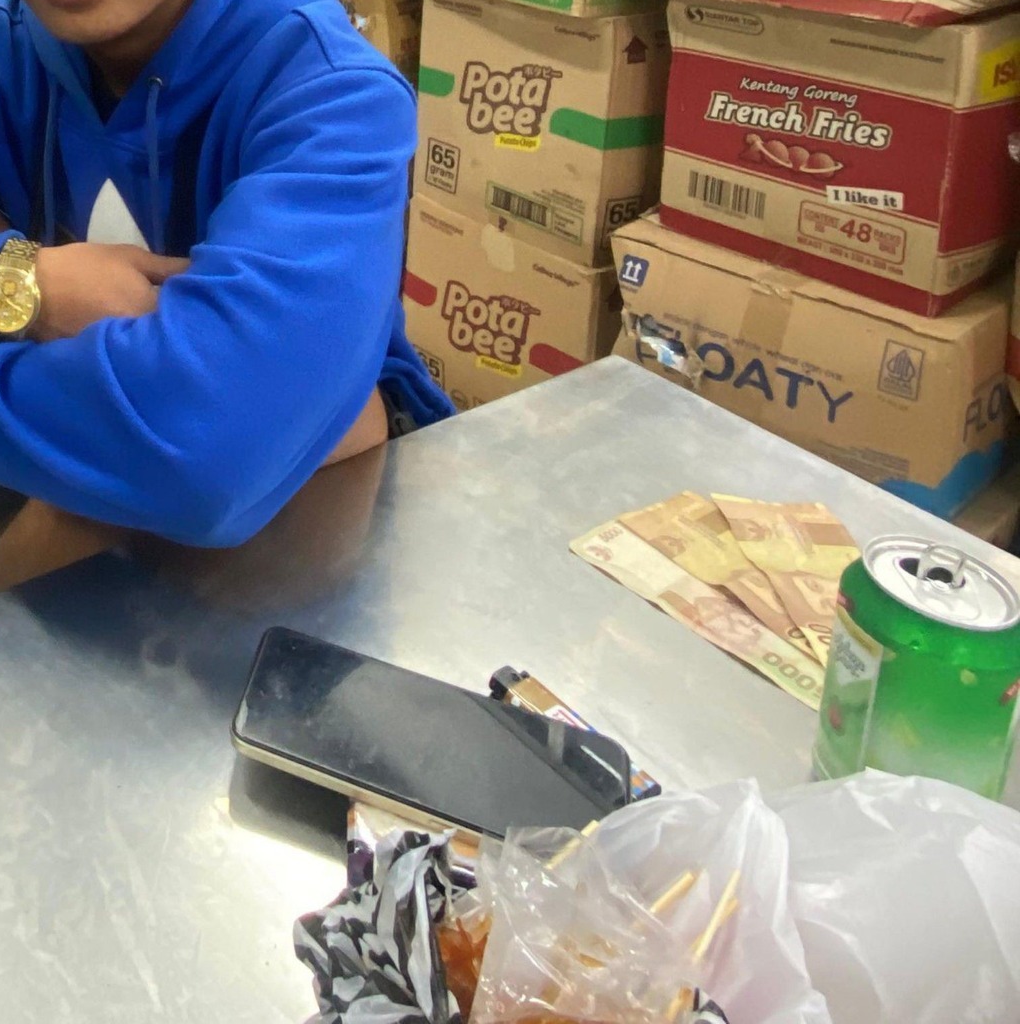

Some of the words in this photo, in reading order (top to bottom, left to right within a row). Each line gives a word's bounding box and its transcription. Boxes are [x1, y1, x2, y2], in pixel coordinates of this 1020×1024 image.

[462, 62, 550, 109] Pota
[739, 77, 798, 100] Kentang
[803, 85, 858, 108] Goreng
[468, 91, 538, 134] bee
[705, 91, 805, 134] French
[808, 108, 892, 150] Fries
[430, 164, 454, 180] gram
[431, 144, 455, 169] 65
[609, 202, 638, 226] 65
[833, 189, 841, 201] I
[844, 190, 878, 206] like
[883, 194, 898, 208] it
[839, 219, 872, 243] 48
[443, 281, 527, 340] Pota
[450, 310, 518, 364] bee
